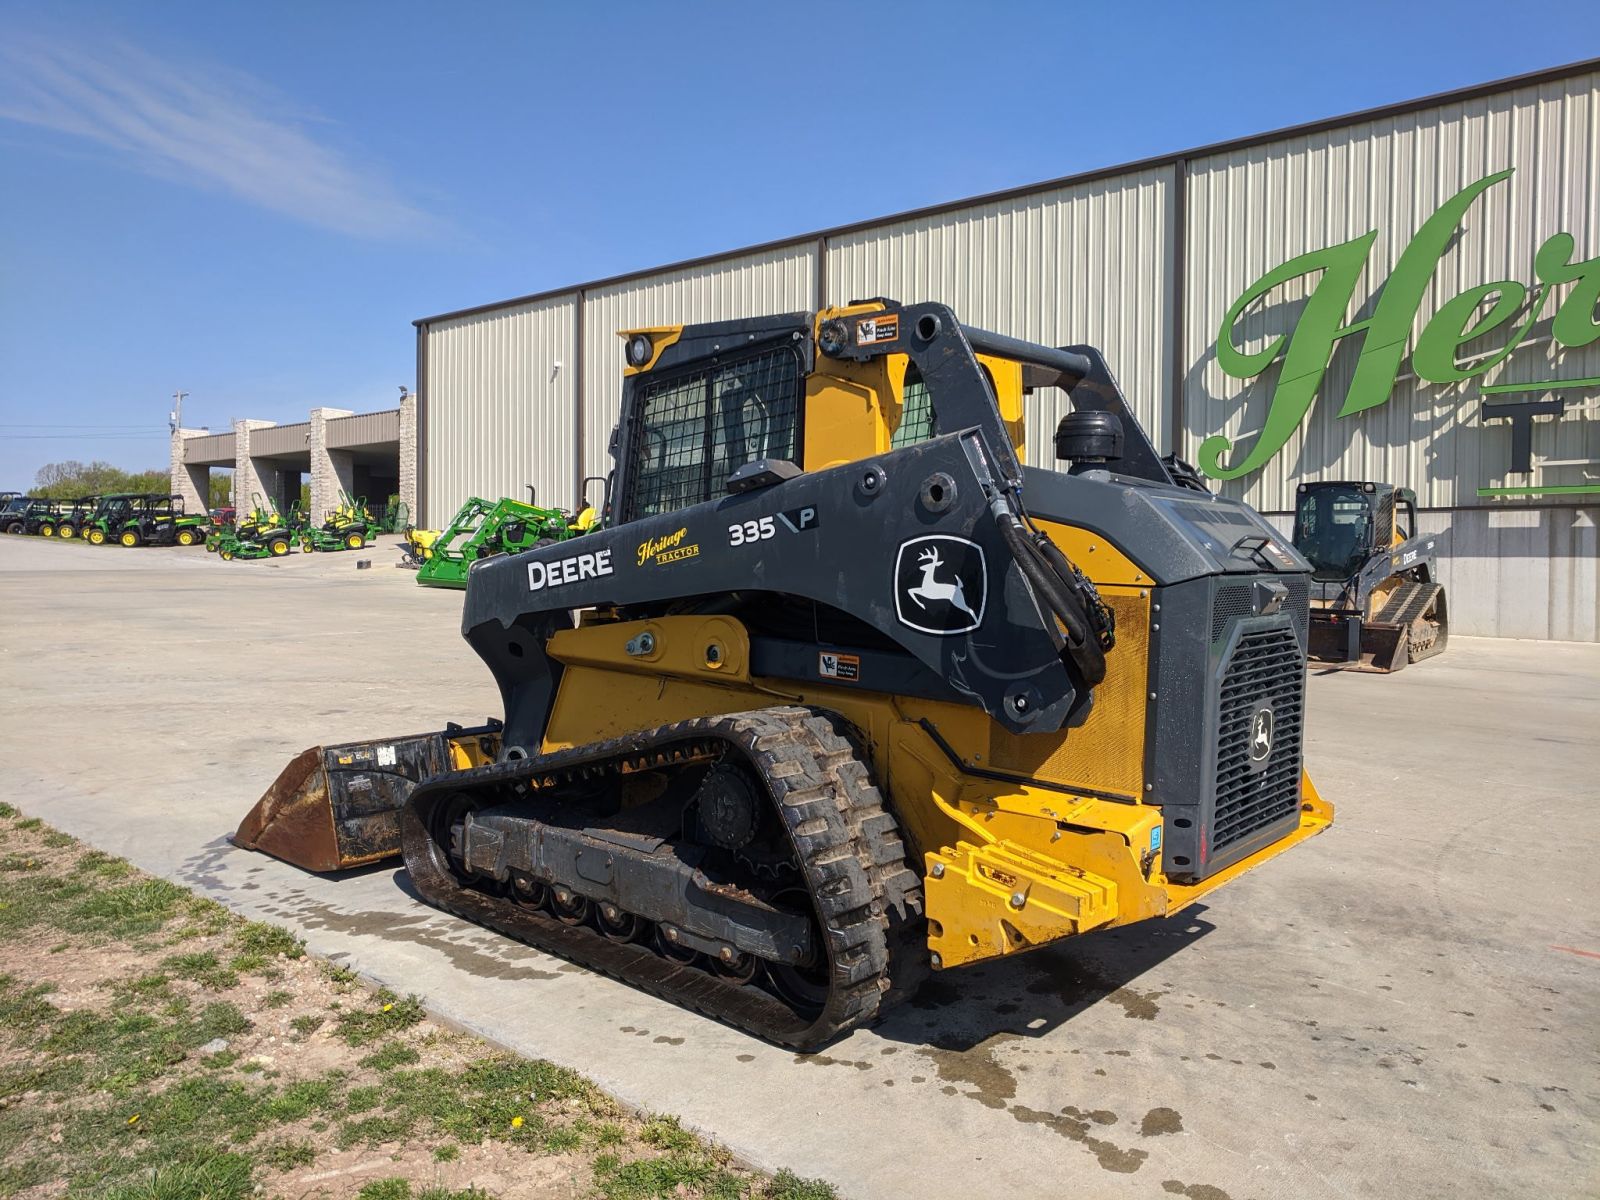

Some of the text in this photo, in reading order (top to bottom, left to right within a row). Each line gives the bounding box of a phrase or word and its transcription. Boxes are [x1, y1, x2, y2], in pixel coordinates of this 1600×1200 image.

[637, 527, 688, 566] Heritage
[728, 515, 776, 547] 335
[527, 549, 613, 591] DEERE
[655, 546, 699, 563] TRACTOR
